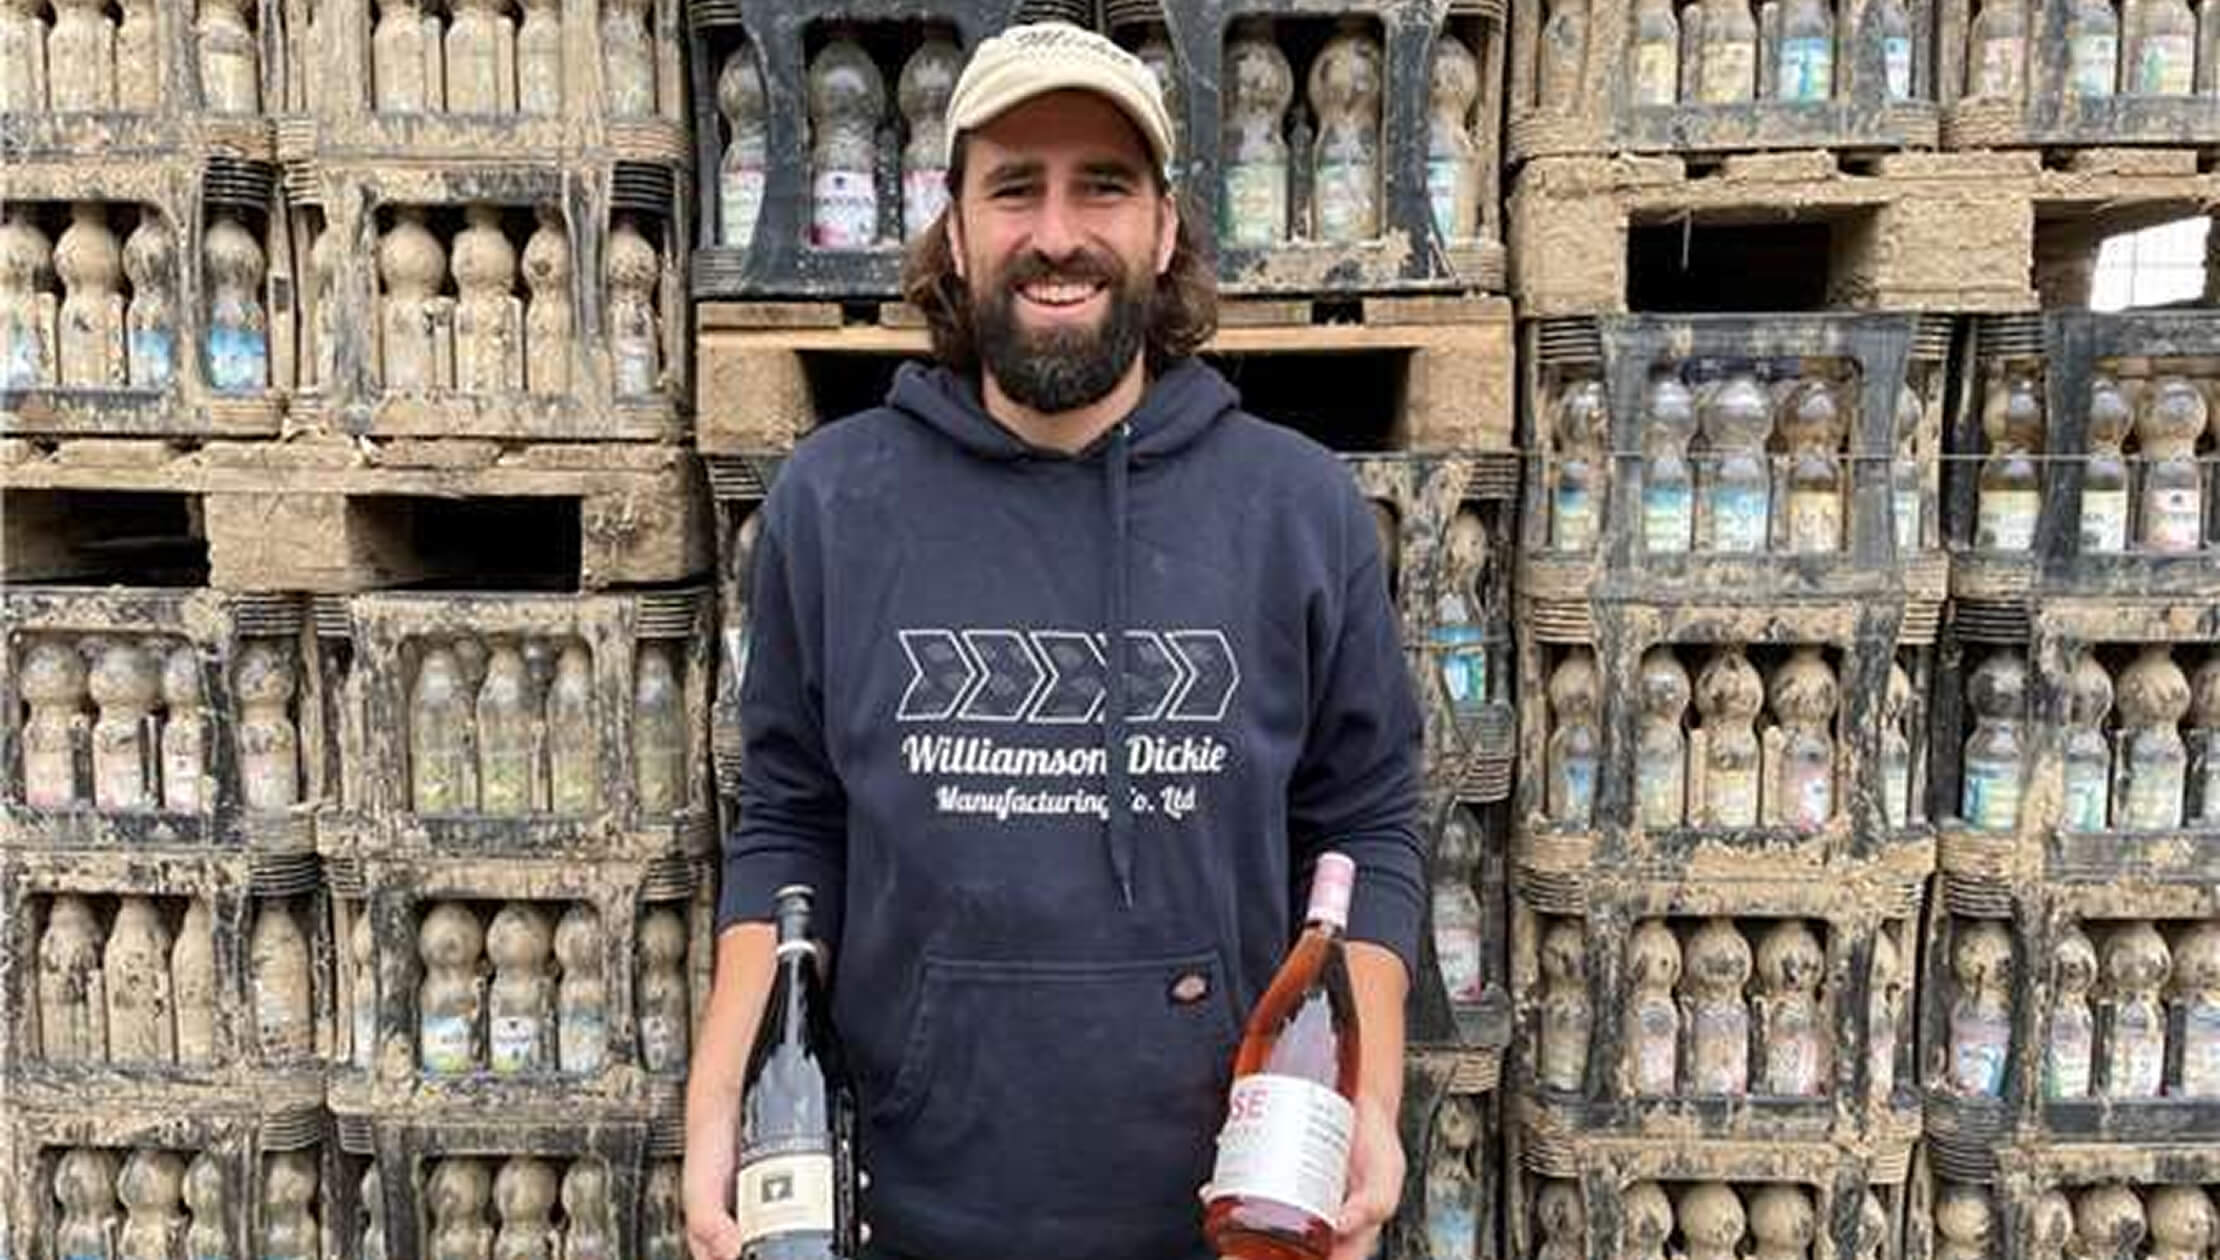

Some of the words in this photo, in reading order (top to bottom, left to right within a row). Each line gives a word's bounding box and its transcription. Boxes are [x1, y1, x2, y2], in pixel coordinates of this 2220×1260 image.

[902, 734, 1108, 775] Williamson
[1125, 734, 1227, 774] Dickie
[935, 785, 1110, 821] Manufacturing
[1129, 786, 1155, 812] o.
[1160, 784, 1196, 820] Ltd
